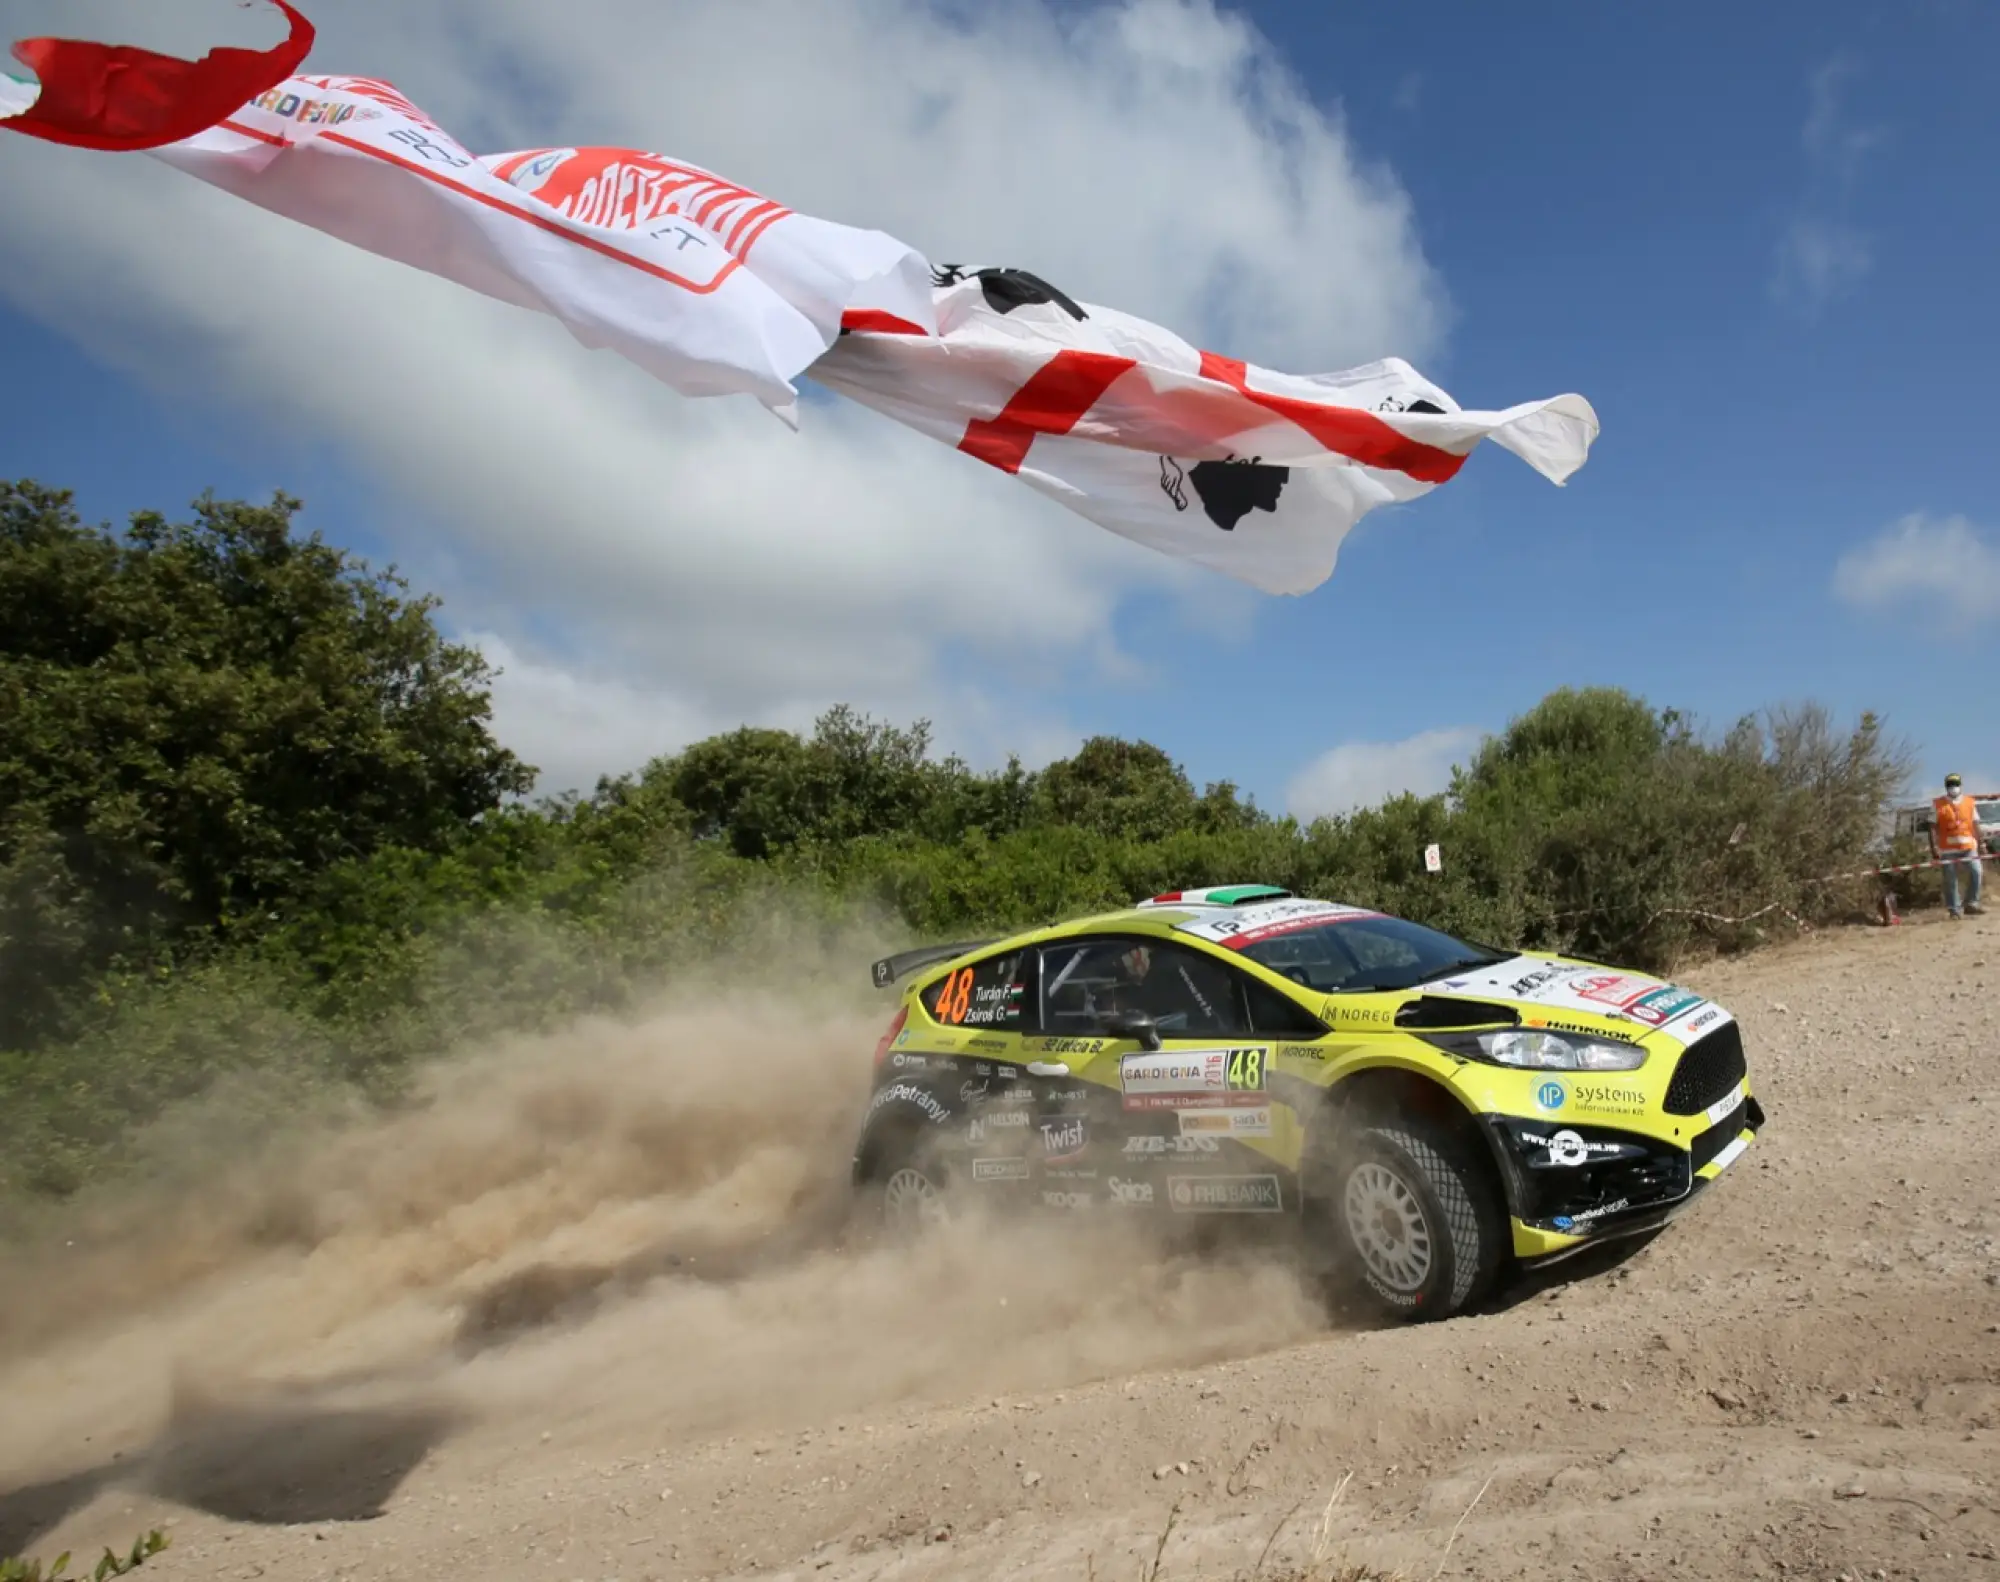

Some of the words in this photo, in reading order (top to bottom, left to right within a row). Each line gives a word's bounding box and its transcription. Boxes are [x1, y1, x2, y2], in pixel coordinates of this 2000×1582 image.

[934, 967, 974, 1024] 48
[1341, 1008, 1391, 1023] NOREG
[1124, 1066, 1200, 1081] SARDEGNA
[1204, 1055, 1223, 1087] 2016
[1229, 1050, 1260, 1089] 48
[1543, 1086, 1560, 1105] IP
[1575, 1086, 1646, 1104] systems
[1041, 1120, 1083, 1152] Twist
[1108, 1176, 1154, 1206] Spice
[1229, 1184, 1276, 1203] BANK
